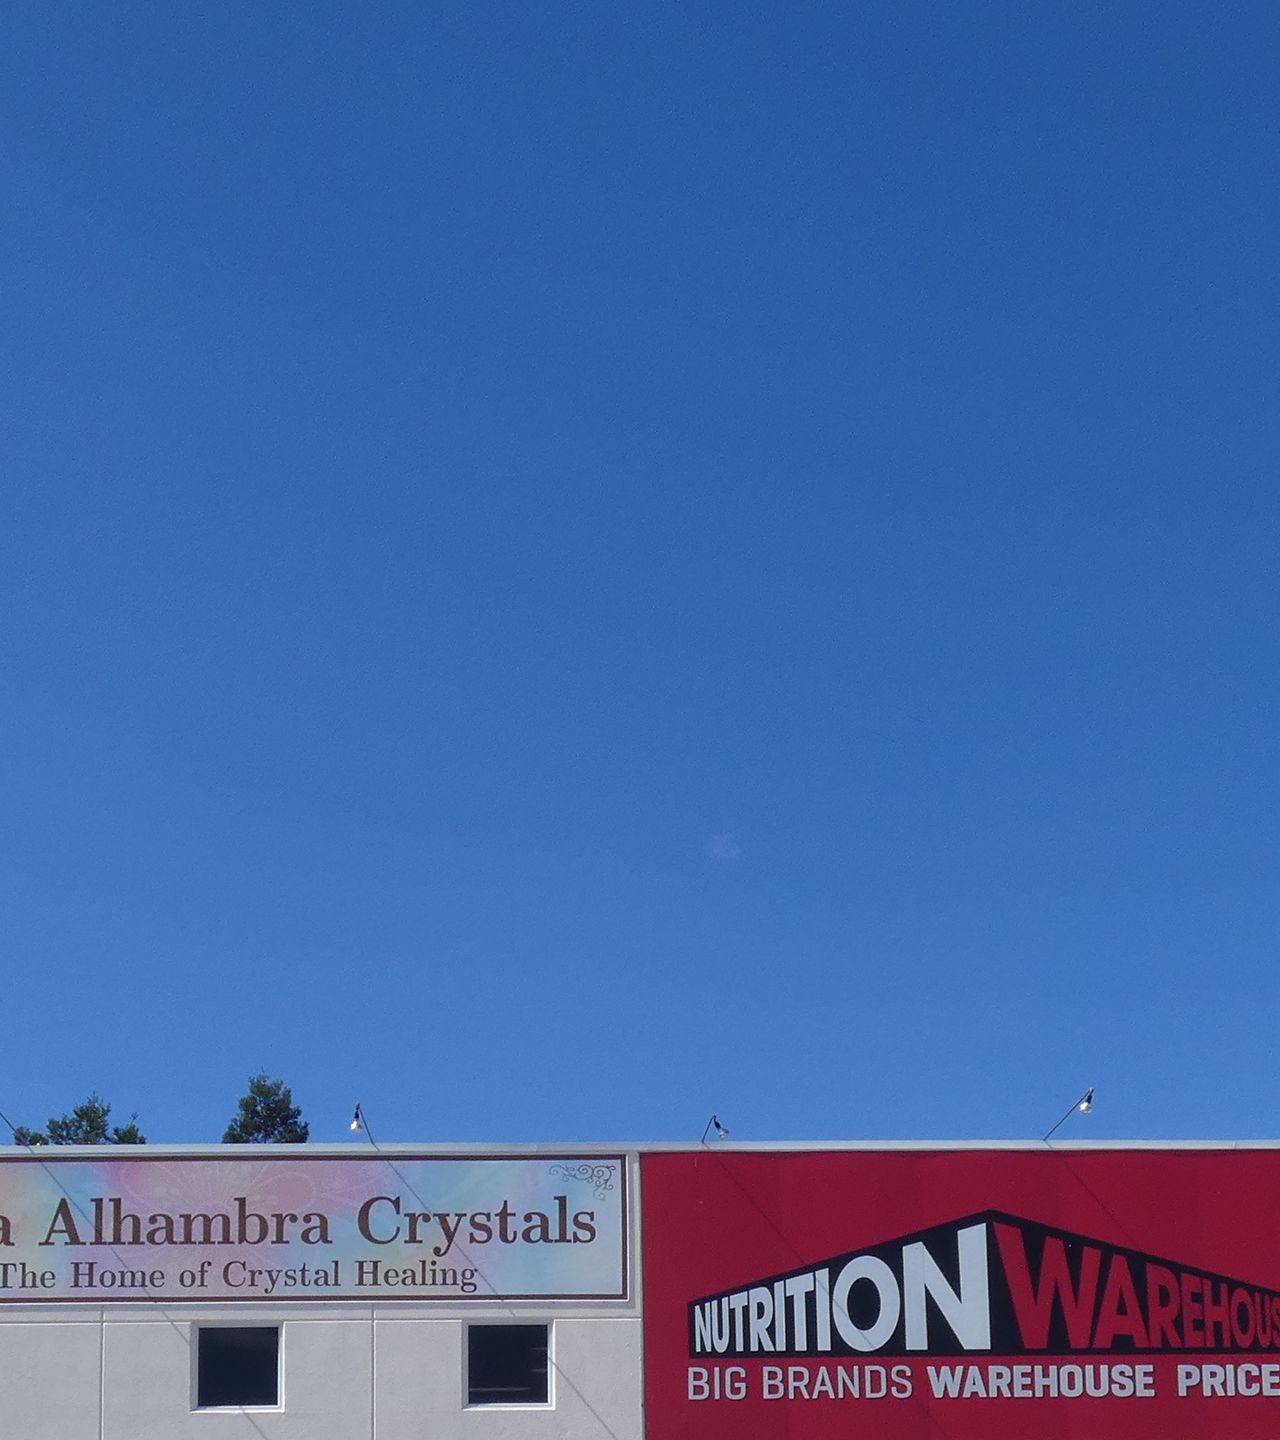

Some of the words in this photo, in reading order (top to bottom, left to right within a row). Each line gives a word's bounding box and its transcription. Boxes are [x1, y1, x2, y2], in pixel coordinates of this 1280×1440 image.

[39, 1197, 332, 1247] Alhambra
[357, 1195, 597, 1255] Crystals
[69, 1261, 166, 1289] Home
[178, 1260, 210, 1288] of
[222, 1260, 341, 1295] Crystal
[354, 1259, 478, 1292] Healing
[694, 1223, 991, 1353] NUTRITION
[688, 1366, 747, 1400] BIG
[762, 1365, 913, 1399] BRANDS
[928, 1363, 1155, 1398] WAREHOUSE
